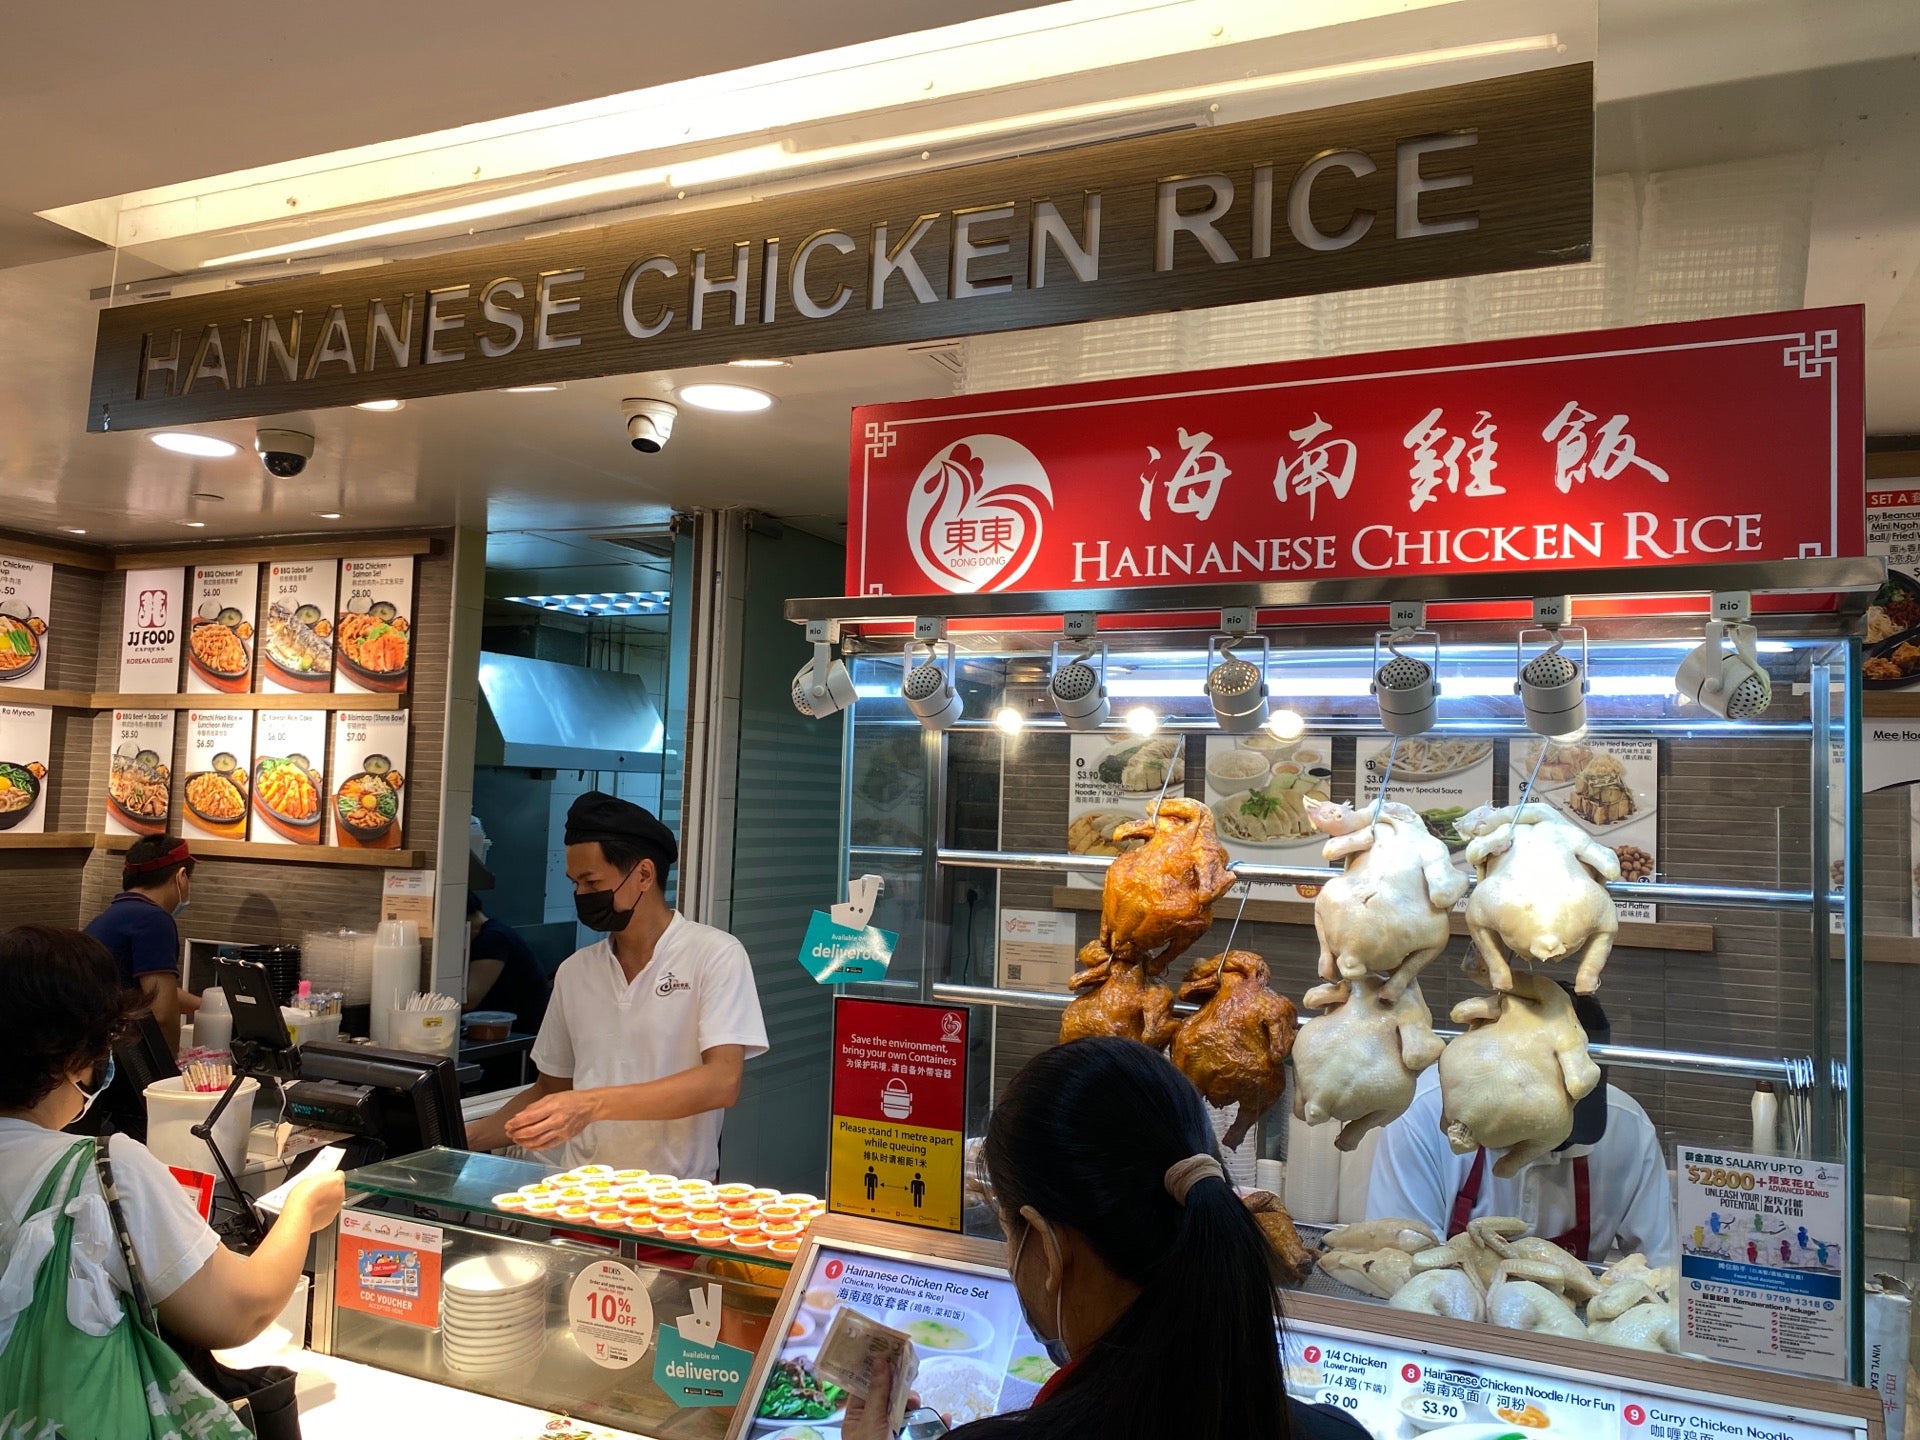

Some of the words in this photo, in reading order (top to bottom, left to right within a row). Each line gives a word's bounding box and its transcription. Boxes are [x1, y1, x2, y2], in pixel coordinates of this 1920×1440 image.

[135, 271, 583, 401] HAINANESE
[619, 189, 1101, 340] CHICKEN
[1154, 127, 1480, 273] RICE
[1138, 400, 1670, 523] 海南雞飯
[1871, 494, 1893, 505] SET
[1897, 493, 1908, 504] A
[1893, 521, 1918, 531] Ngoh
[944, 515, 1015, 556] 東東
[1892, 532, 1914, 540] Fried
[1072, 535, 1337, 583] HAINANESE
[1352, 522, 1604, 571] CHICKEN
[1623, 512, 1763, 561] RICE
[365, 562, 387, 570] Chicken
[950, 558, 977, 568] DONG
[978, 556, 1006, 567] DONG
[215, 570, 235, 578] Chicken
[352, 570, 372, 578] Salmon
[203, 588, 220, 597] $6.00
[279, 585, 298, 594] $6.50
[352, 589, 371, 598] $8.00
[127, 631, 141, 646] JJ
[142, 629, 175, 646] FOOD
[121, 730, 138, 739] $8.50
[346, 732, 367, 742] $7.00
[1873, 730, 1899, 739] Mee
[197, 739, 215, 748] $6.50
[1077, 771, 1099, 780] $3.90
[1416, 786, 1440, 794] Special
[850, 1033, 871, 1045] Save
[872, 1036, 887, 1047] the
[888, 1039, 948, 1054] environment,
[842, 1044, 864, 1058] bring
[866, 1049, 885, 1059] your
[888, 1052, 907, 1061] own
[908, 1051, 957, 1066] Containers
[839, 1121, 867, 1134] Please
[868, 1126, 892, 1138] stand
[894, 1129, 898, 1138] 1
[901, 1131, 928, 1142] metre
[929, 1136, 954, 1146] apart
[864, 1138, 888, 1149] while
[889, 1142, 927, 1157] queuing
[1725, 1156, 1769, 1171] SALARY
[1770, 1163, 1786, 1172] UP
[1787, 1165, 1803, 1175] TO
[1768, 1175, 1815, 1189] 预支花红
[1705, 1188, 1739, 1200] UNLEASH
[1740, 1192, 1760, 1203] YOUR
[1768, 1185, 1804, 1195] ADVANCED
[1805, 1189, 1829, 1198] BONUS
[1720, 1198, 1760, 1212] POTENTIAL
[1764, 1204, 1804, 1217] 加入我们
[845, 1264, 898, 1283] Hainanese
[900, 1274, 943, 1291] Chicken
[944, 1282, 969, 1296] Rice
[970, 1287, 989, 1300] Set
[841, 1276, 875, 1290] (Chicken,
[877, 1283, 916, 1297] Vegetables
[925, 1292, 944, 1303] Rice)
[1704, 1284, 1729, 1294] 6773
[1732, 1288, 1757, 1299] 7878
[1766, 1293, 1792, 1303] 9799
[1795, 1298, 1820, 1308] 1318
[360, 1291, 376, 1302] CDC
[376, 1294, 413, 1311] VOUCHER
[1733, 1297, 1783, 1311] Remuneration
[617, 1314, 637, 1327] OFF
[682, 1350, 710, 1360] Available
[1325, 1350, 1341, 1361] 1/4
[1343, 1352, 1388, 1369] Chicken
[1871, 1344, 1881, 1370] VINYL
[665, 1360, 739, 1383] deliveroo
[1323, 1360, 1347, 1371] (Lower
[1349, 1365, 1366, 1376] part)
[1422, 1380, 1480, 1403] 海南鸡面
[1497, 1395, 1526, 1412] 河粉
[1423, 1367, 1478, 1387] Hainanese
[1479, 1378, 1523, 1395] Chicken
[1525, 1386, 1564, 1402] Noodle
[1570, 1394, 1592, 1408] Hor
[1593, 1399, 1615, 1412] Fun
[1422, 1400, 1458, 1419] $3.90
[1650, 1409, 1686, 1427] Curry
[1689, 1416, 1743, 1435] Chicken
